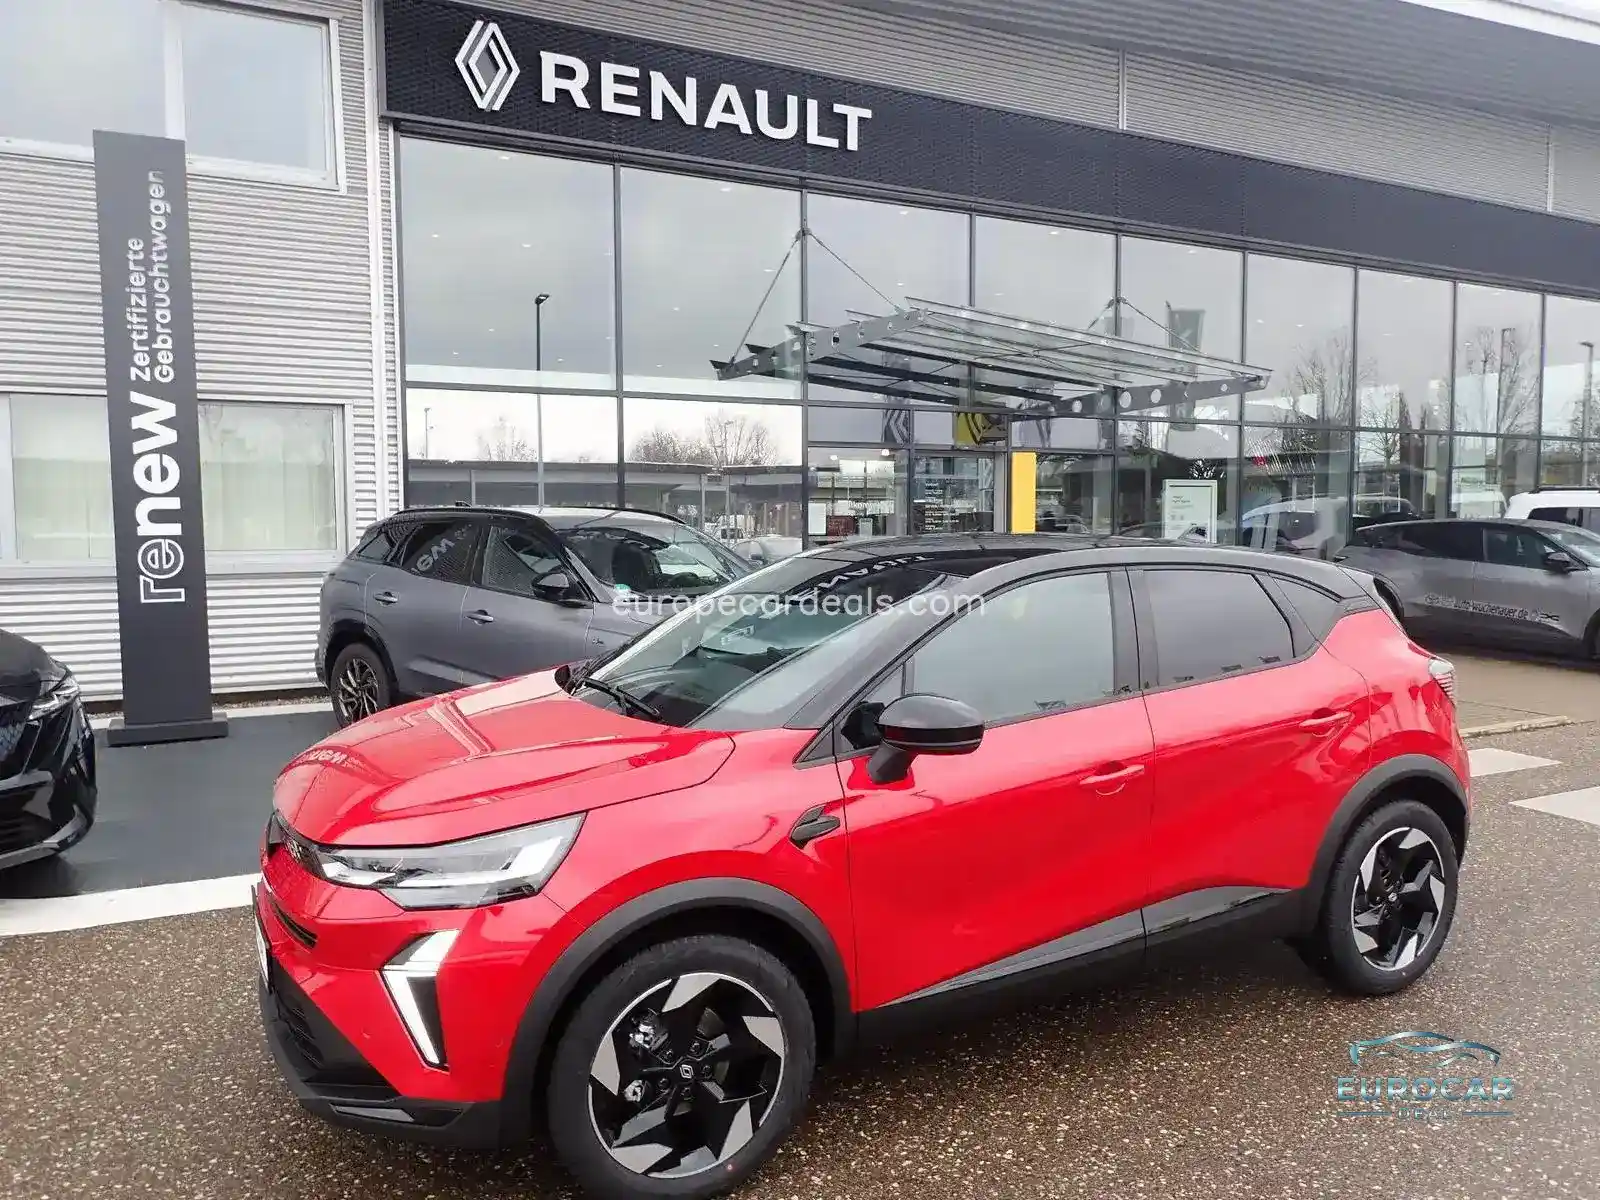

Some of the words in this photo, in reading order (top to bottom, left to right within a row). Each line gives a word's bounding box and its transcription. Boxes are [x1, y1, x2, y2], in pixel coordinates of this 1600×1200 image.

[539, 50, 872, 151] RENAULT
[125, 237, 151, 382] Zertifizierte
[148, 170, 175, 383] Gebrauchtwagen
[129, 390, 186, 603] renew
